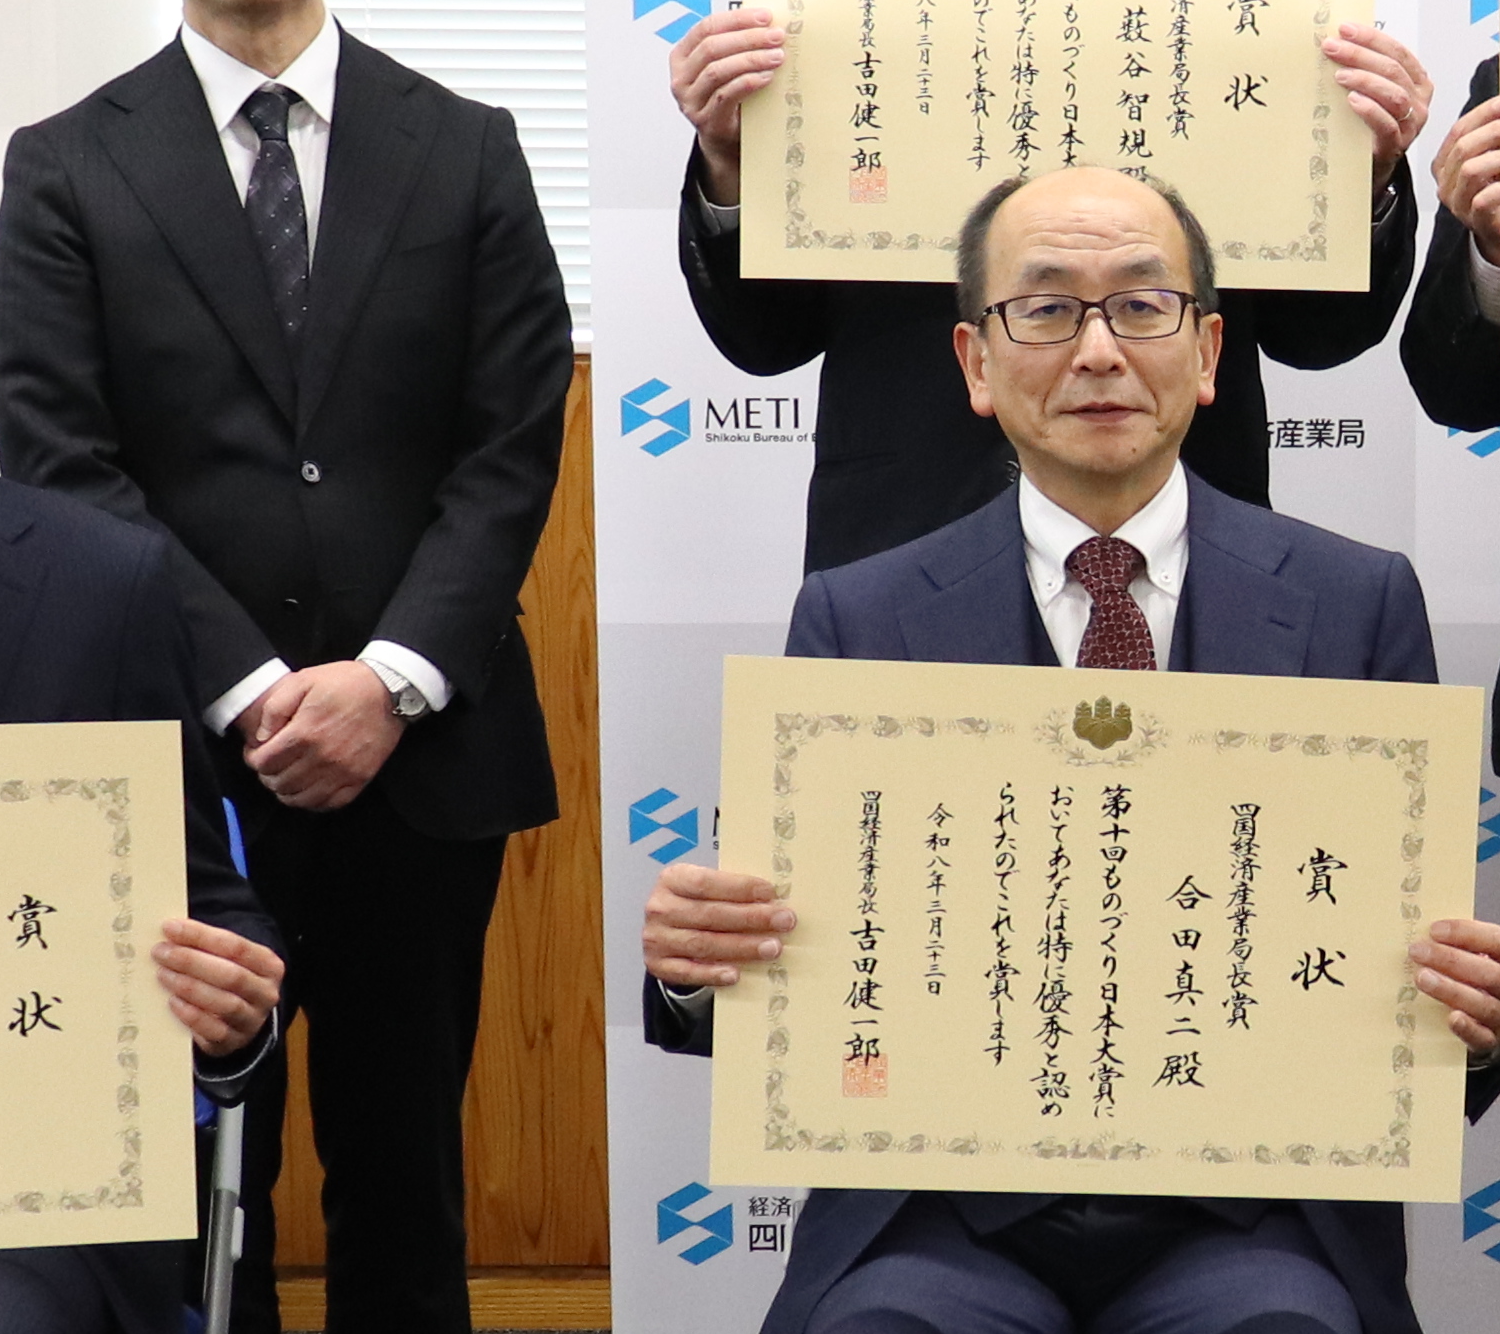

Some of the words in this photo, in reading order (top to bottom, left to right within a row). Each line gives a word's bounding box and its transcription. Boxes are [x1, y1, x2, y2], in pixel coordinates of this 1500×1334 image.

[705, 397, 800, 430] METI
[704, 432, 751, 443] Shikoku
[752, 432, 794, 443] Bureau
[796, 432, 809, 443] of
[1267, 418, 1365, 449] 産業局
[924, 802, 954, 996] 令和八年三月二十三日
[1221, 802, 1262, 1028] 四国経済産業局長賞
